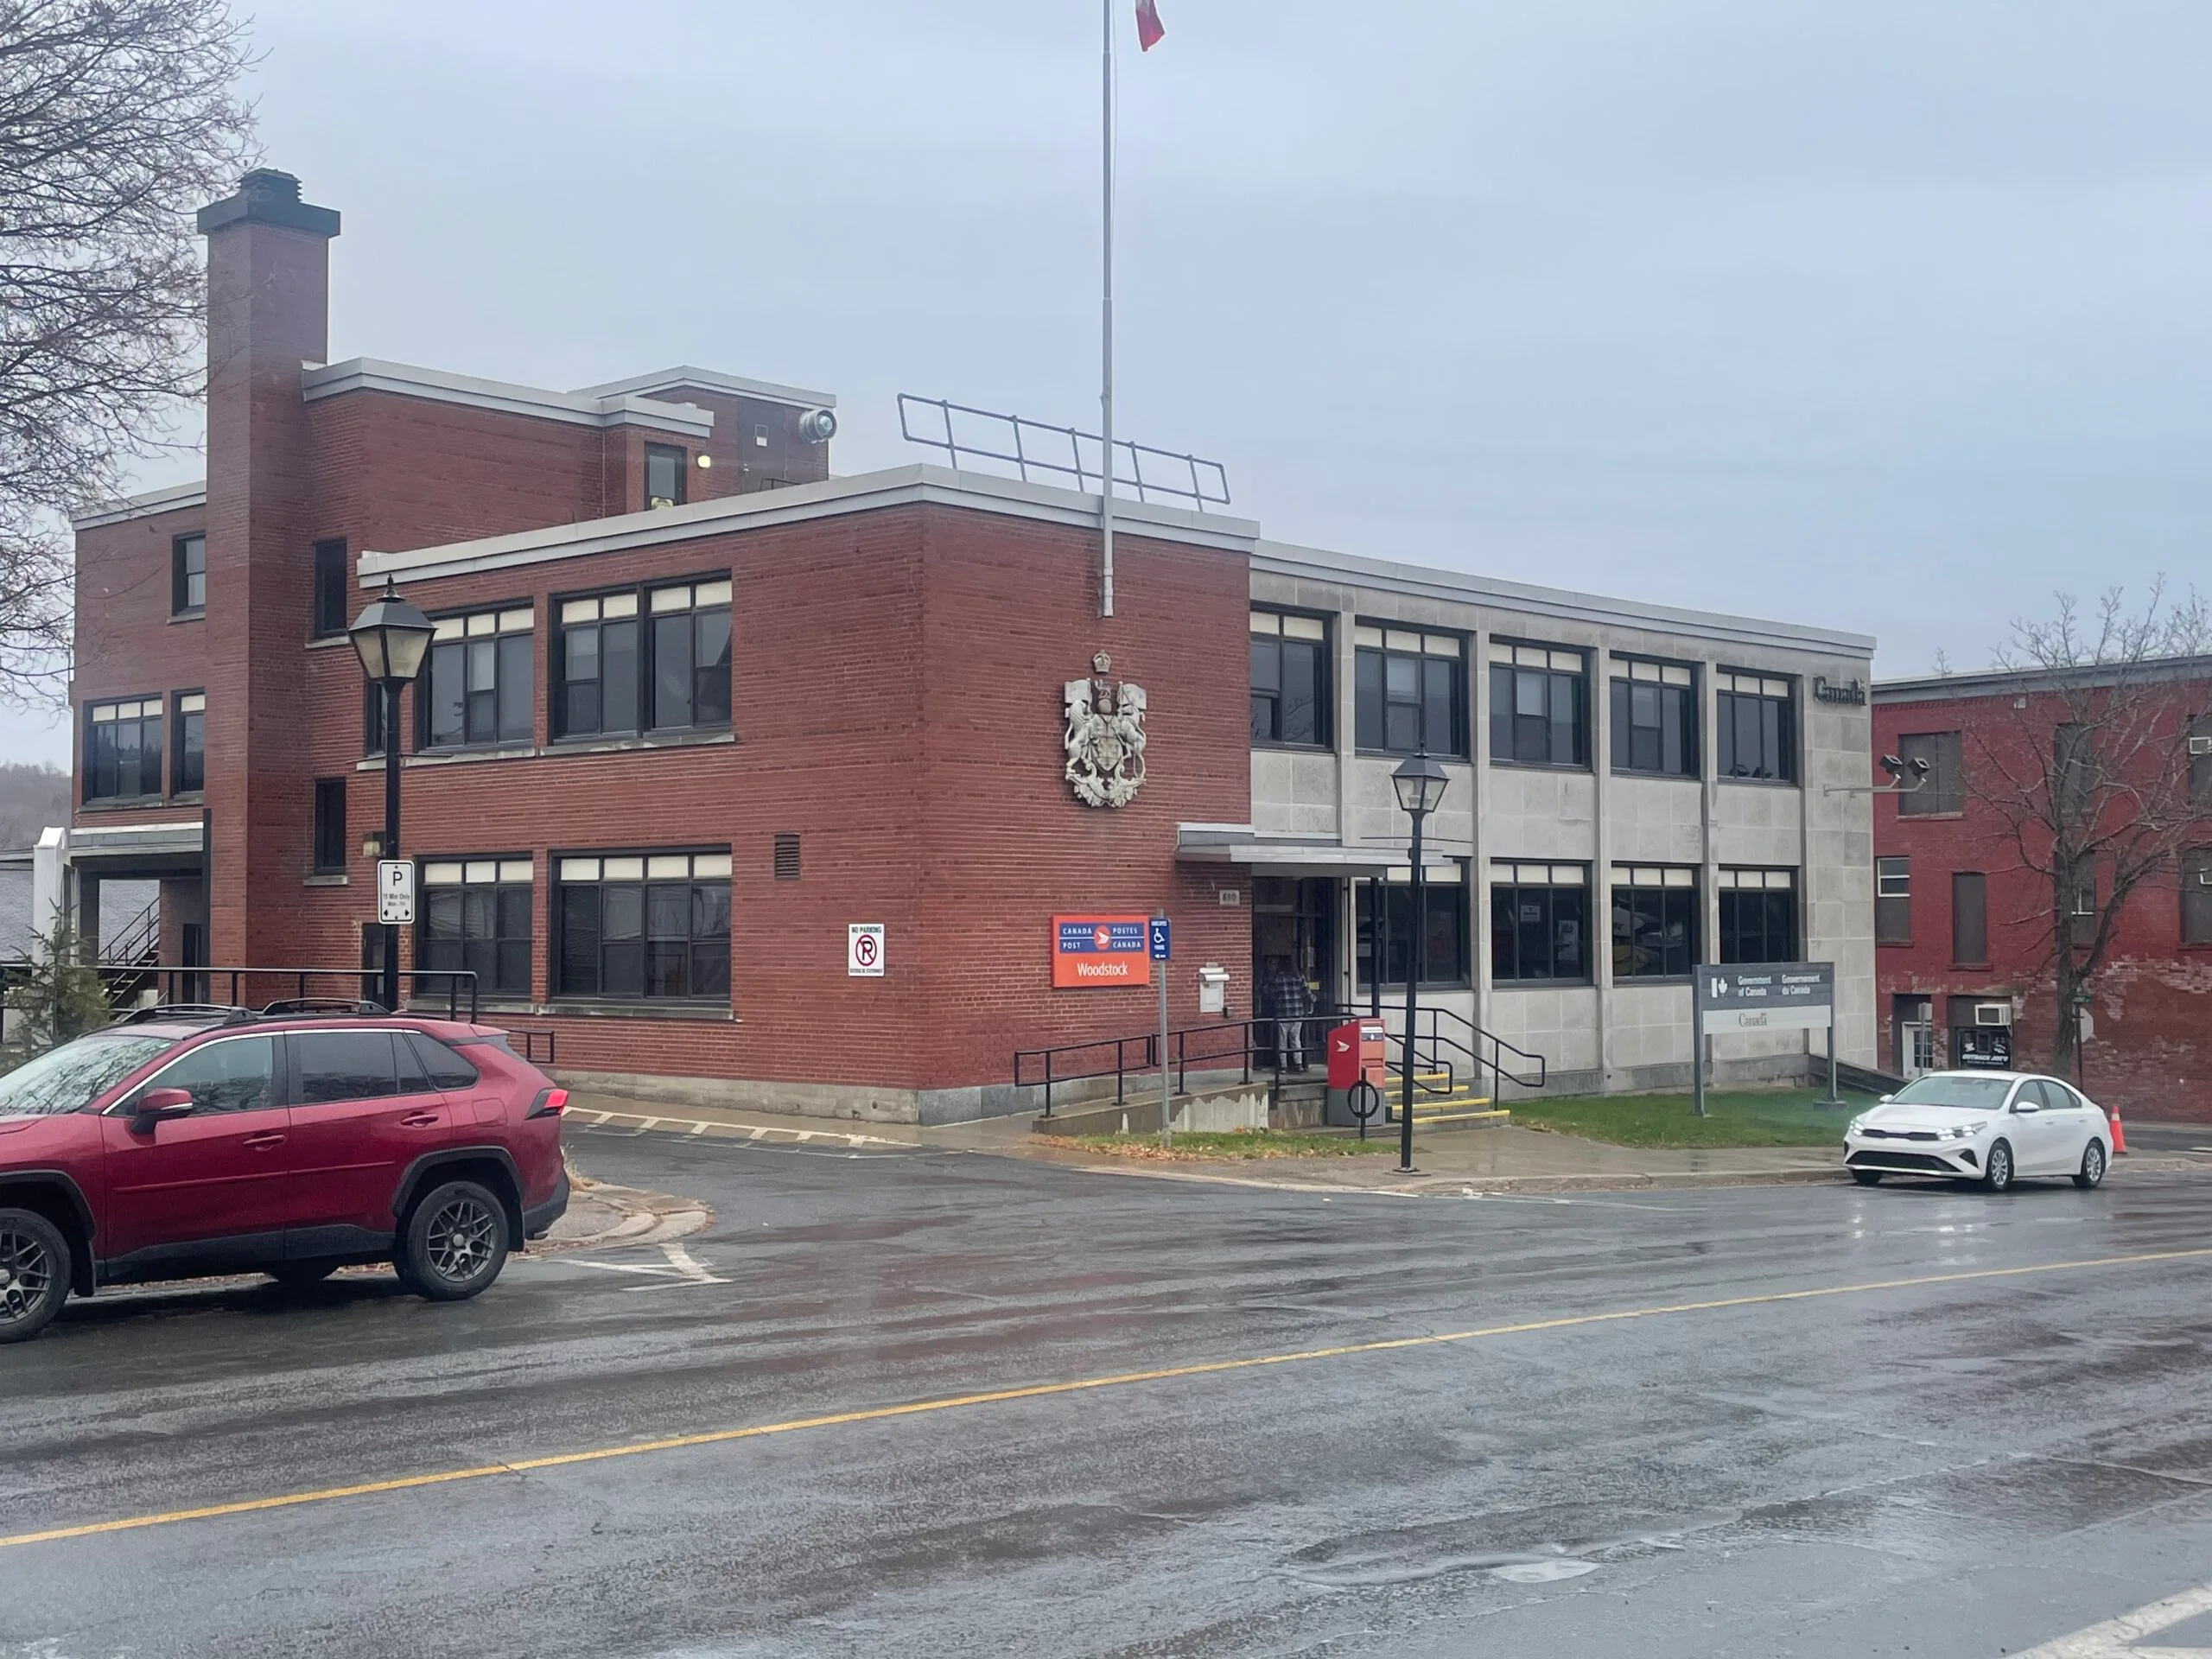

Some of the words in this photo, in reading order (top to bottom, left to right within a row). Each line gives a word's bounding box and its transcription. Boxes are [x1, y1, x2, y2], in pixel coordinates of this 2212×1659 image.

[1813, 676, 1867, 706] Canada
[392, 871, 403, 887] P
[1112, 940, 1141, 949] CANADA
[1077, 962, 1128, 976] Woodstock
[1737, 976, 1772, 985] Government
[1781, 975, 1821, 984] Gouvernement
[1738, 988, 1745, 997] of
[1745, 987, 1767, 996] Canada
[1782, 987, 1789, 995] du
[1790, 986, 1811, 995] Canada
[1738, 1012, 1768, 1027] Canada
